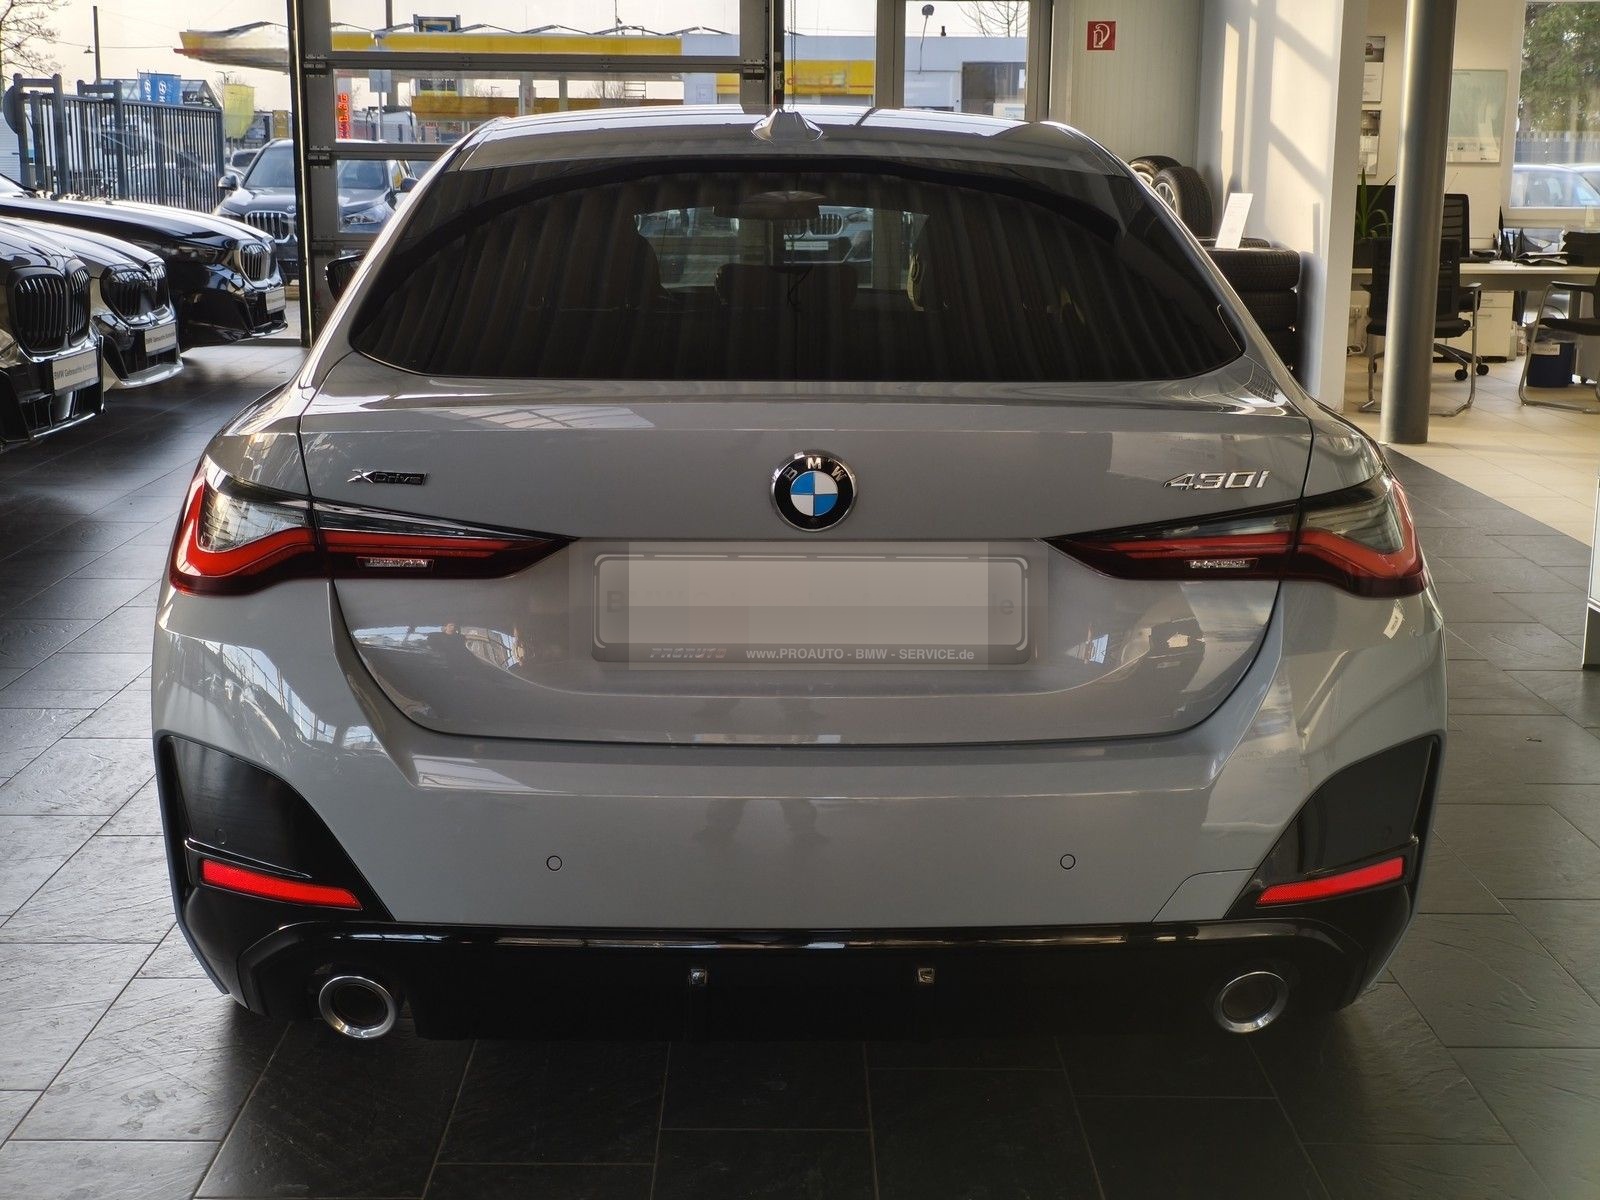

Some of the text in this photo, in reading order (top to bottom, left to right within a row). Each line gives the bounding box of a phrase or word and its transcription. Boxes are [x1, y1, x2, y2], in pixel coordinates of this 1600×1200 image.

[783, 457, 847, 482] BMW
[1163, 470, 1270, 490] 430i
[745, 648, 844, 660] www.PROAUTO
[855, 648, 888, 660] BMW
[899, 648, 975, 661] SERVICE.de
